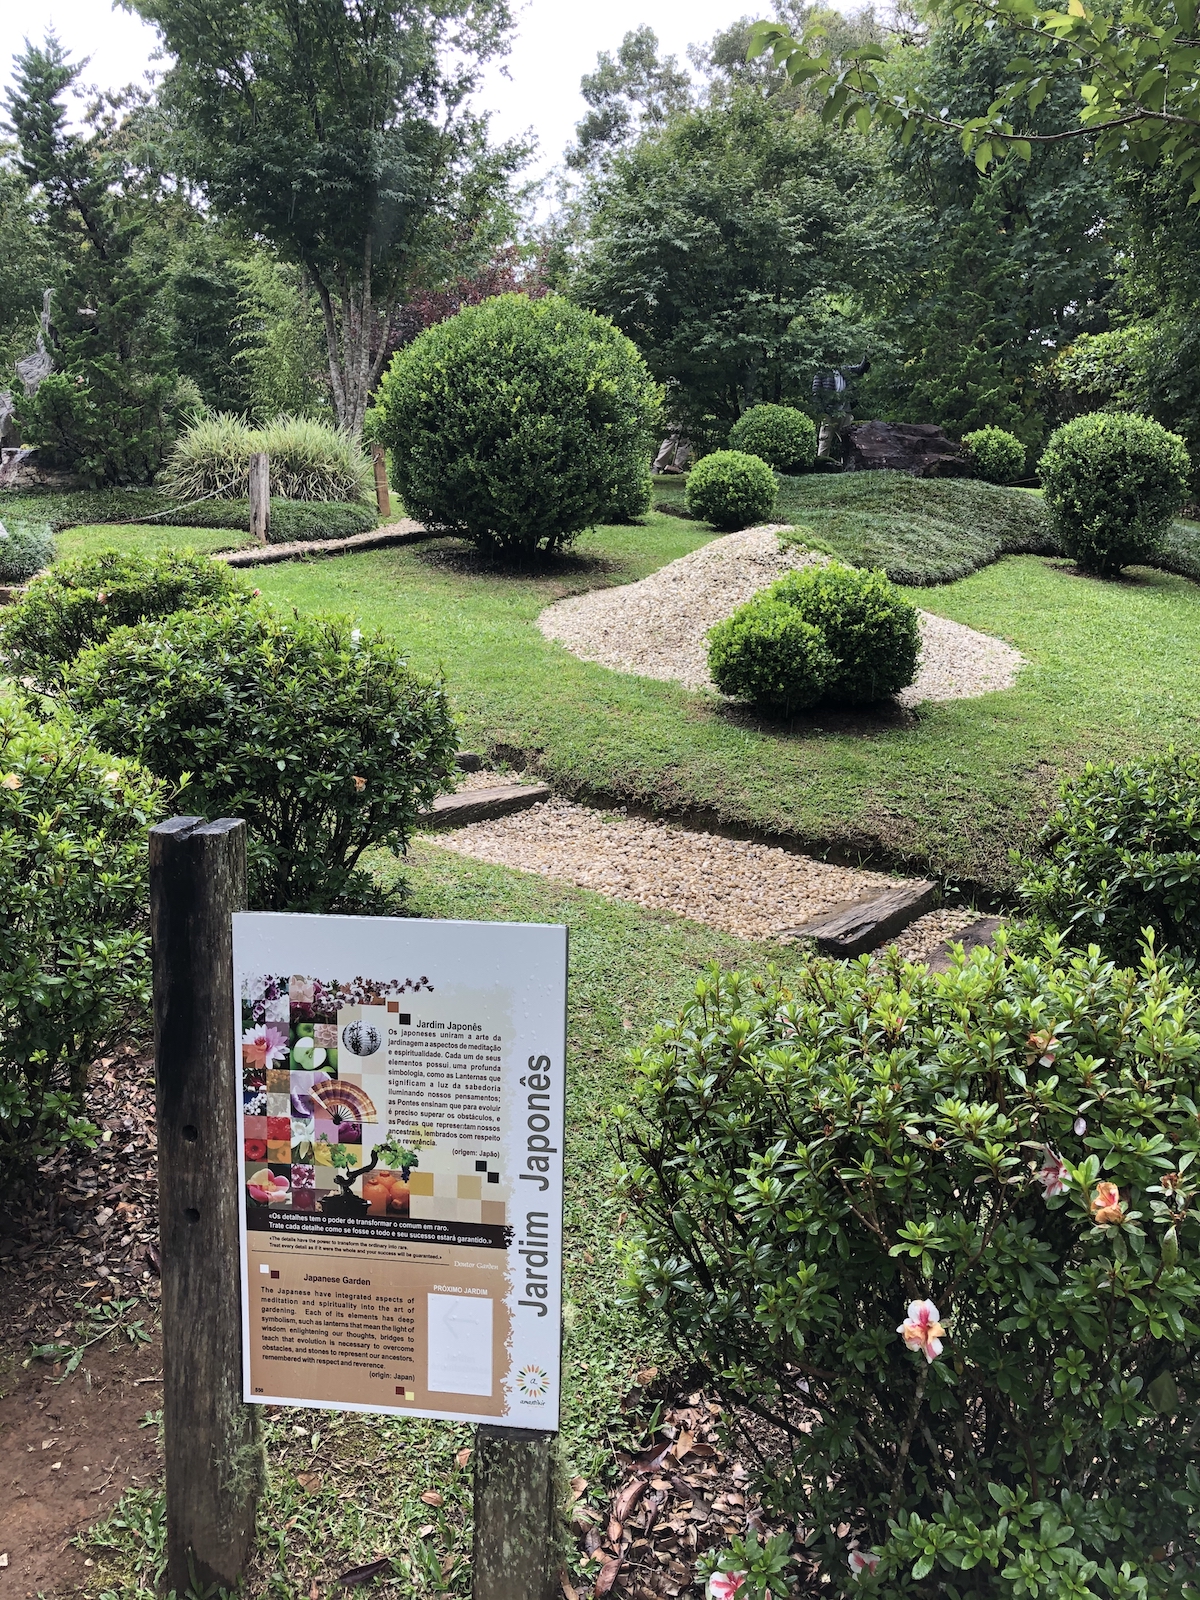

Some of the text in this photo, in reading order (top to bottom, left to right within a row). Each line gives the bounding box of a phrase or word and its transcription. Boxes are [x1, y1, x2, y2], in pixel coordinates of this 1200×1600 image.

[416, 1020, 482, 1033] Jardim Japonês
[388, 1028, 397, 1036] Os
[401, 1028, 436, 1038] japoneses
[440, 1030, 464, 1039] uniram
[475, 1032, 489, 1040] arte
[493, 1033, 501, 1041] da
[388, 1038, 424, 1049] jardinagem
[429, 1041, 458, 1050] aspectos
[459, 1042, 467, 1050] de
[468, 1042, 501, 1053] meditação
[394, 1048, 442, 1058] espiritualidade.
[445, 1051, 461, 1059] Cada
[475, 1052, 483, 1060] de
[388, 1058, 422, 1068] elementos
[470, 1063, 501, 1072] profunda
[388, 1068, 425, 1079] simbologia,
[455, 1071, 487, 1081] Lanternas
[388, 1078, 426, 1088] significam
[437, 1080, 448, 1088] luz
[452, 1081, 460, 1089] da
[465, 1082, 500, 1091] sabedoria
[388, 1087, 424, 1097] iluminando
[455, 1093, 500, 1103] pensamentos;
[397, 1098, 419, 1107] Pontes
[421, 1100, 448, 1108] ensinam
[478, 1103, 500, 1112] evoluir
[388, 1107, 392, 1115] é
[394, 1108, 418, 1117] preciso
[420, 1111, 444, 1119] superar
[457, 1112, 494, 1122] obstáculos,
[396, 1118, 418, 1127] Pedras
[436, 1122, 476, 1130] representam
[387, 1128, 422, 1138] ancestrais,
[424, 1129, 457, 1139] lembrados
[474, 1133, 500, 1143] respeito
[402, 1138, 437, 1147] reverência.
[452, 1147, 500, 1160] (origem: Japão)
[518, 1055, 557, 1317] Jardim Japonês
[282, 1212, 308, 1222] detalhes
[309, 1214, 321, 1222] tem
[327, 1216, 346, 1225] poder
[347, 1217, 355, 1225] de
[356, 1217, 392, 1227] transformar
[269, 1221, 284, 1229] Trate
[285, 1222, 300, 1230] cada
[301, 1223, 324, 1232] detalhe
[352, 1226, 369, 1235] fosse
[376, 1228, 390, 1237] todo
[437, 1233, 456, 1241] estará
[304, 1273, 370, 1286] Japanese Garden
[261, 1286, 414, 1304] The Japanese have integrated aspects of
[261, 1296, 298, 1306] meditation
[319, 1300, 356, 1311] spirituality
[361, 1302, 374, 1311] into
[378, 1303, 389, 1312] the
[394, 1305, 403, 1313] art
[261, 1306, 414, 1325] gardening. Each of its elements has deep
[261, 1315, 297, 1326] symbolism,
[298, 1318, 314, 1326] such
[323, 1319, 348, 1328] lanterns
[350, 1321, 362, 1329] that
[381, 1323, 391, 1331] the
[392, 1324, 407, 1334] light
[407, 1325, 414, 1333] of
[261, 1325, 286, 1334] wisdom
[289, 1327, 328, 1338] enlightening
[346, 1330, 376, 1341] thoughts,
[380, 1332, 404, 1343] bridges
[407, 1334, 414, 1342] to
[261, 1334, 279, 1343] teach
[282, 1335, 294, 1344] that
[297, 1337, 326, 1346] evolution
[329, 1338, 335, 1347] is
[338, 1341, 370, 1351] necessary
[373, 1342, 380, 1350] to
[262, 1343, 293, 1354] obstacles,
[295, 1346, 306, 1354] and
[308, 1347, 329, 1356] stones
[330, 1348, 337, 1356] to
[338, 1351, 368, 1359] represent
[381, 1353, 414, 1363] ancestors,
[262, 1354, 301, 1363] remembered
[302, 1356, 315, 1364] with
[316, 1358, 339, 1367] respect
[353, 1361, 385, 1369] reverence.
[369, 1370, 415, 1383] (origin: Japan)
